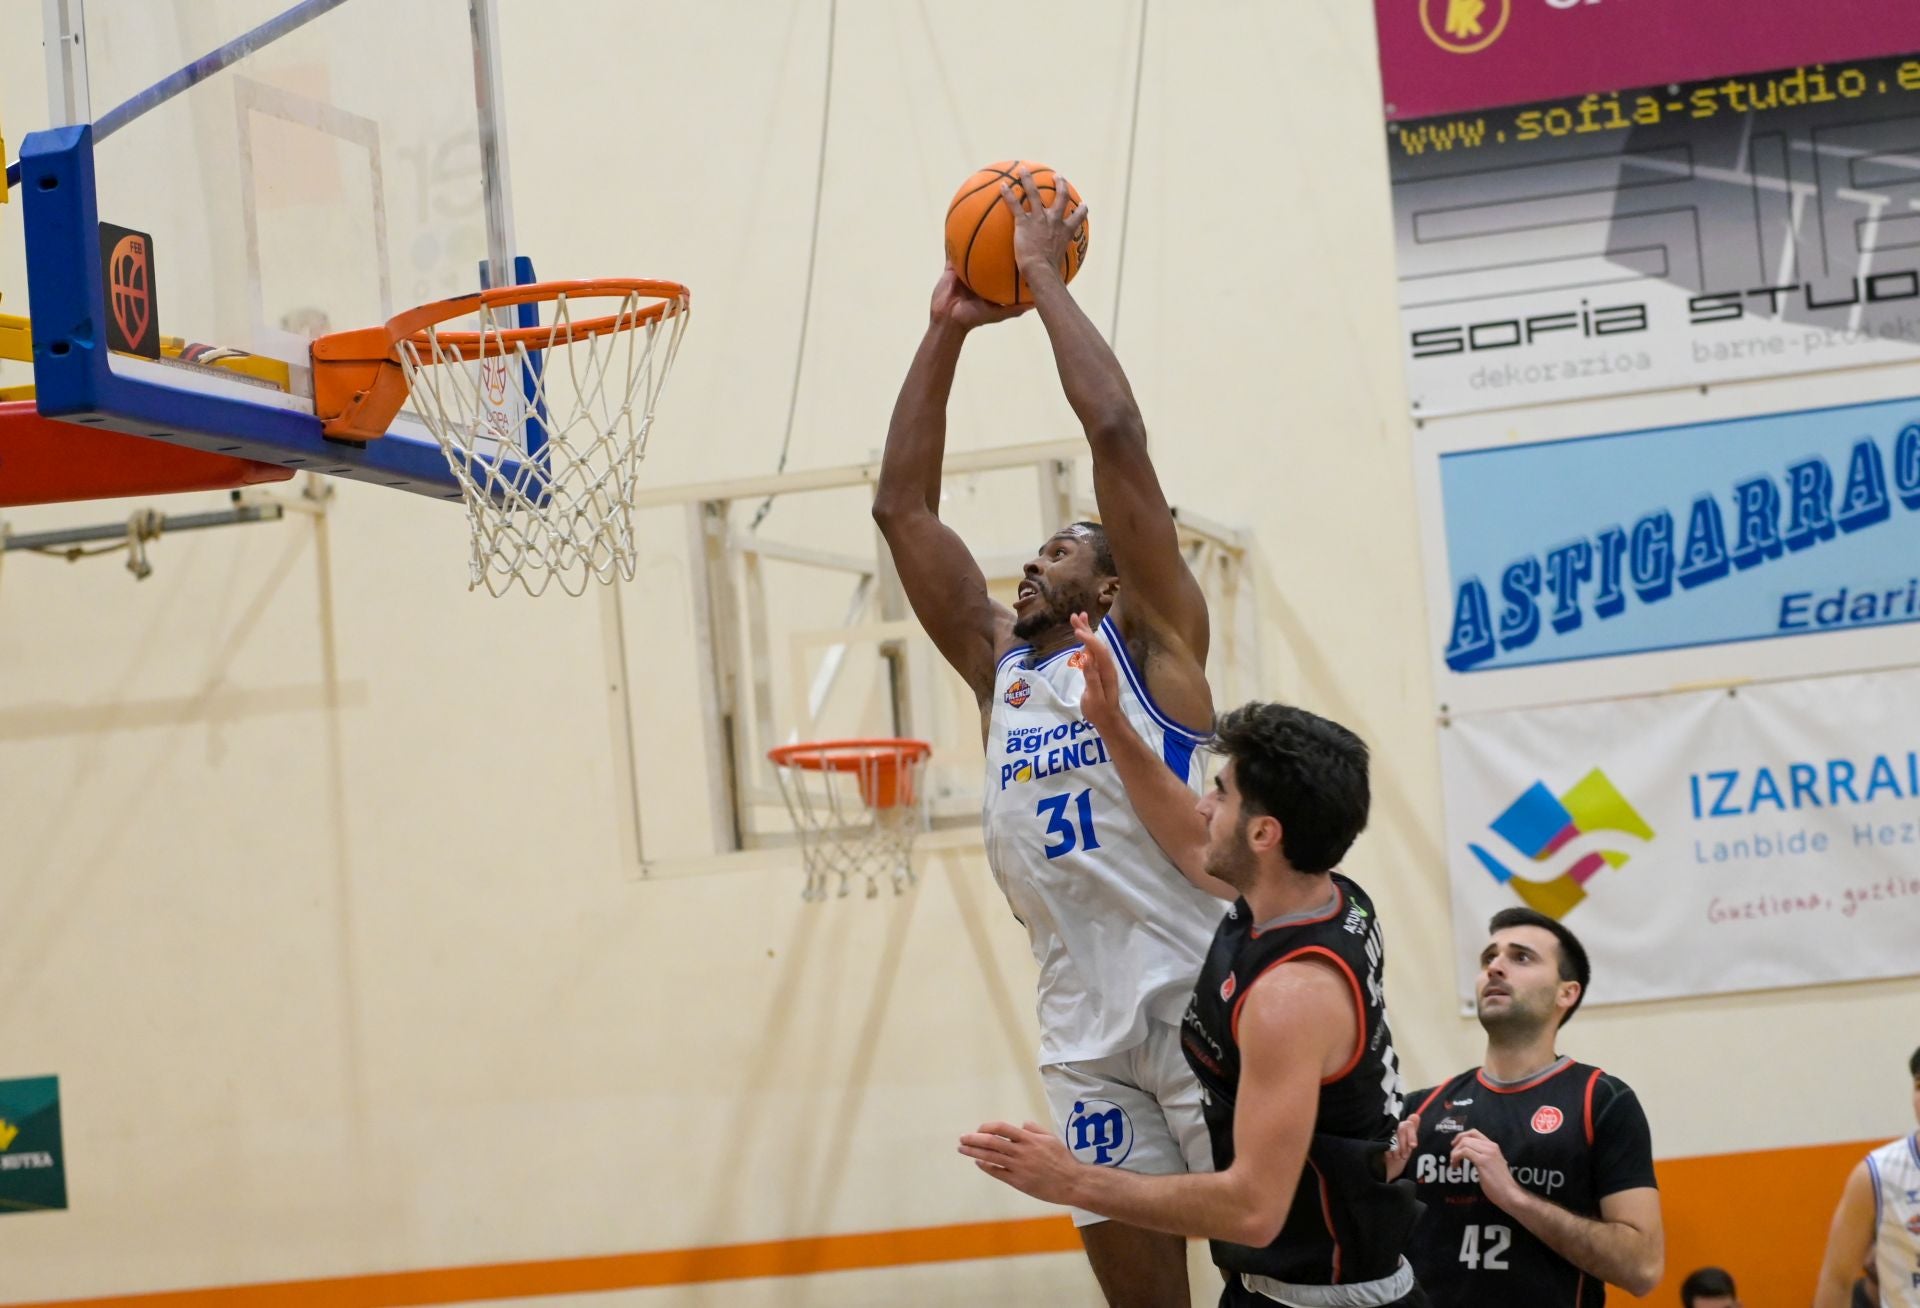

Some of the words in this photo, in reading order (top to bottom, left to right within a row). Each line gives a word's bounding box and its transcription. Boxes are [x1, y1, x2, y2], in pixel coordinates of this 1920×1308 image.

[130, 241, 142, 254] FEB
[1468, 351, 1652, 390] dekorazioa
[1690, 751, 1919, 820] IZARRAI
[1036, 788, 1101, 860] 31
[1695, 830, 1829, 864] Lanbide
[1852, 820, 1920, 847] Hez
[1458, 1224, 1512, 1270] 42
